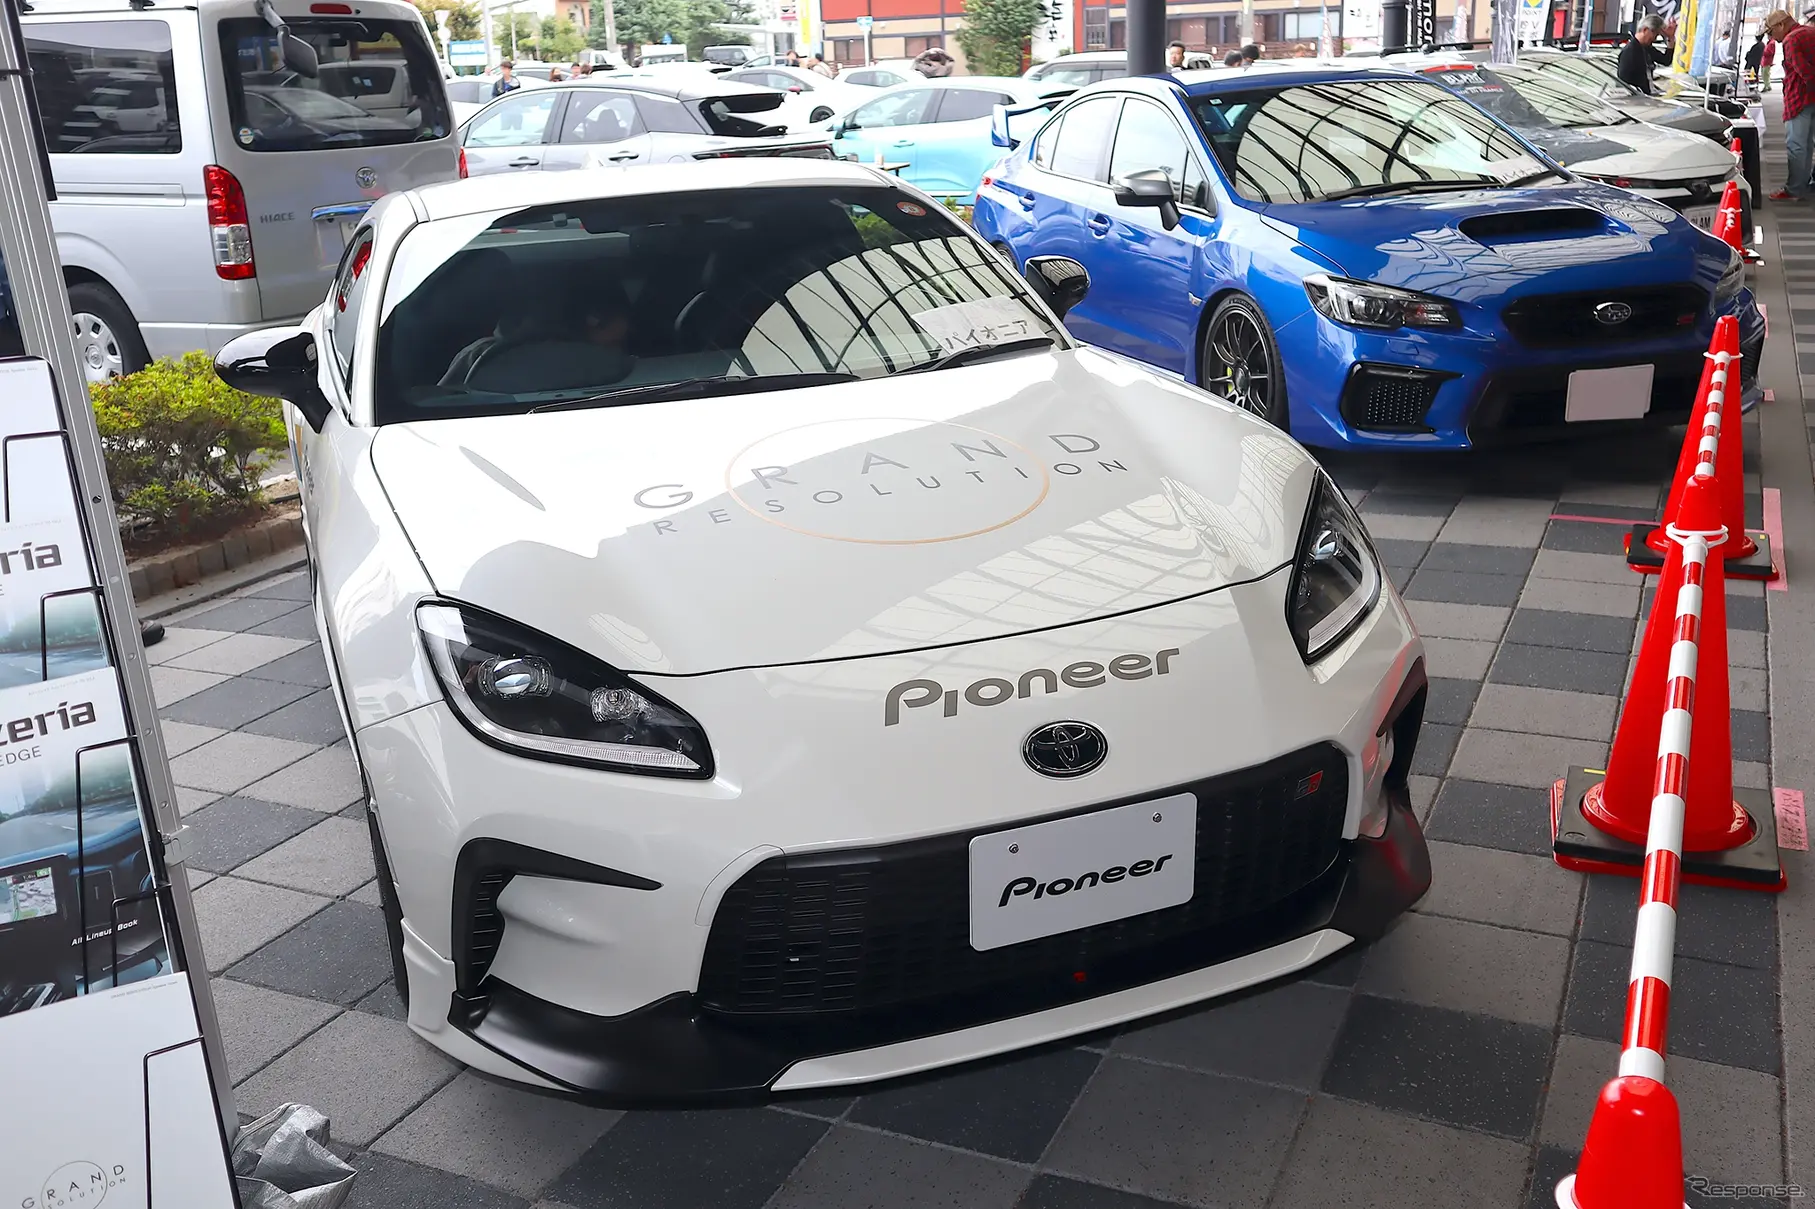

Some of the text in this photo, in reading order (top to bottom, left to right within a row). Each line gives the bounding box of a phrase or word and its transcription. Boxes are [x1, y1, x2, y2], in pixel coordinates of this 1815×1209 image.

[260, 211, 296, 223] HIACE
[945, 319, 1028, 350] パイオニア
[633, 432, 1102, 509] GRAND
[654, 458, 1128, 536] RESOLUTION
[884, 647, 1180, 726] Pioneer
[998, 853, 1173, 907] Pioneer
[71, 937, 83, 946] All
[21, 1164, 124, 1209] GRAND
